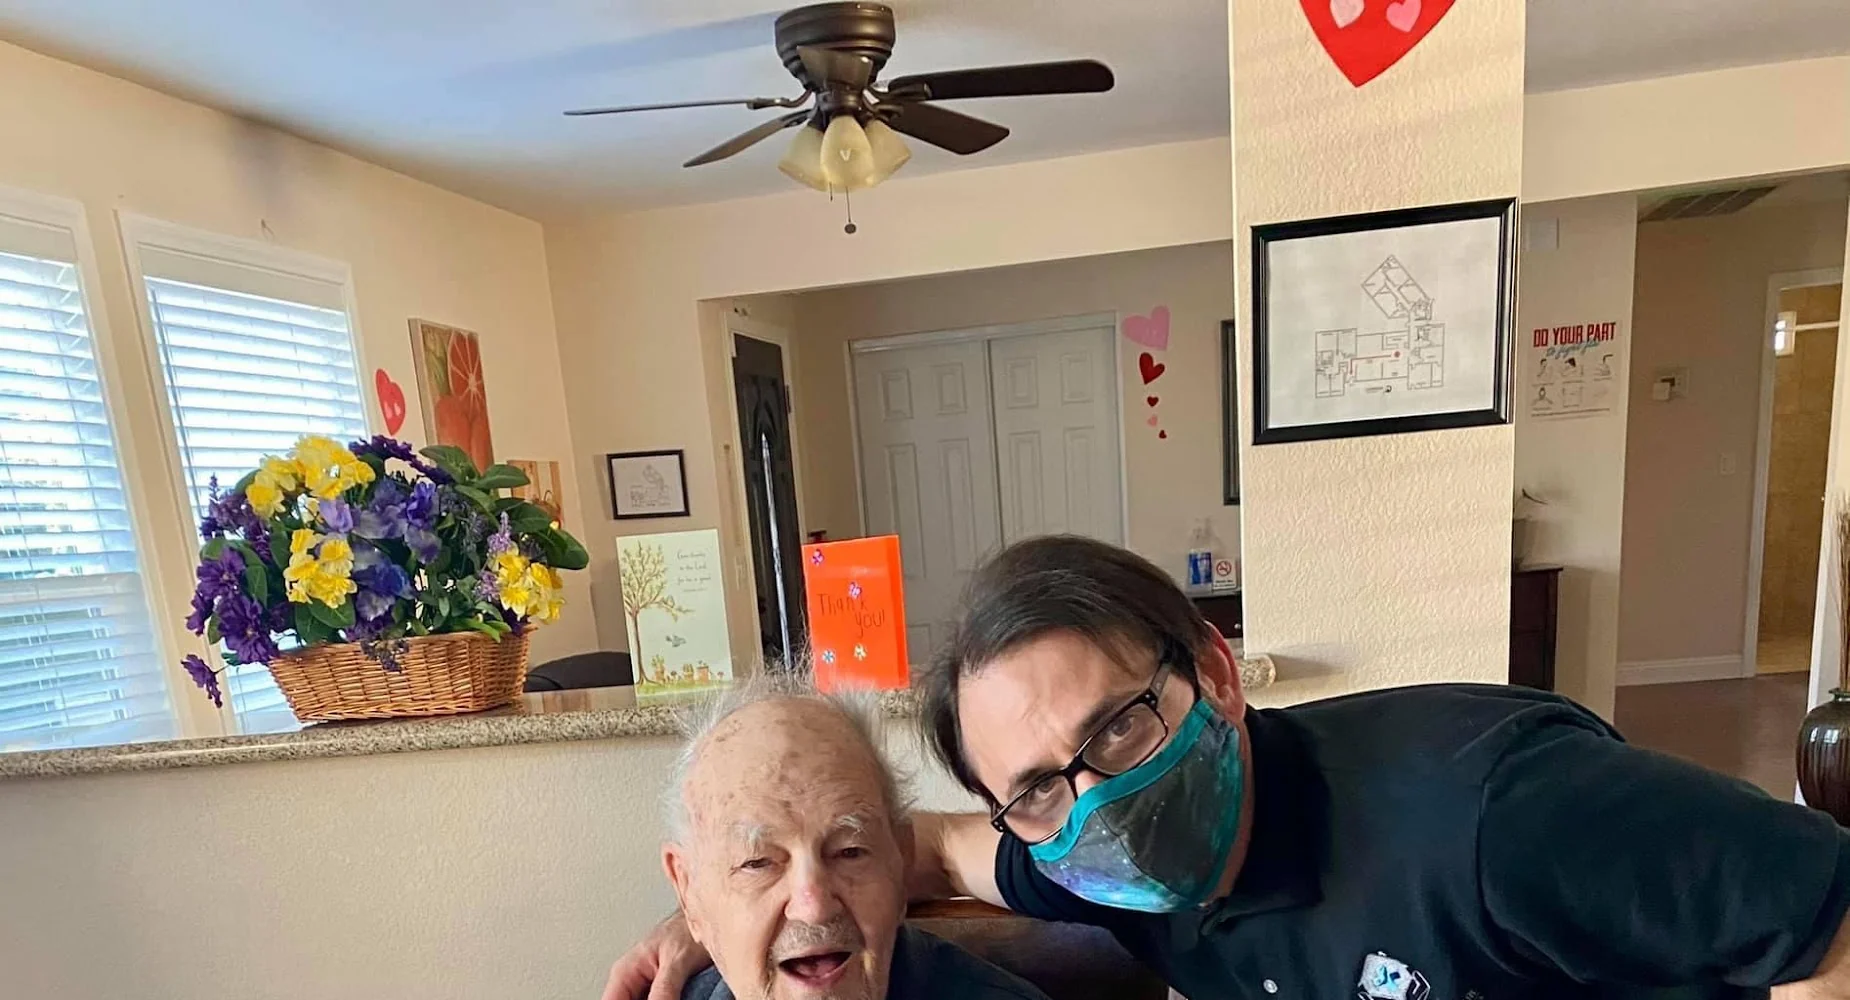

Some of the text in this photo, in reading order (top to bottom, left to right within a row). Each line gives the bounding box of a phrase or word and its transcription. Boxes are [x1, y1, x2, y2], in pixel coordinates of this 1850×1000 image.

[1533, 321, 1616, 348] DO YOUR PART
